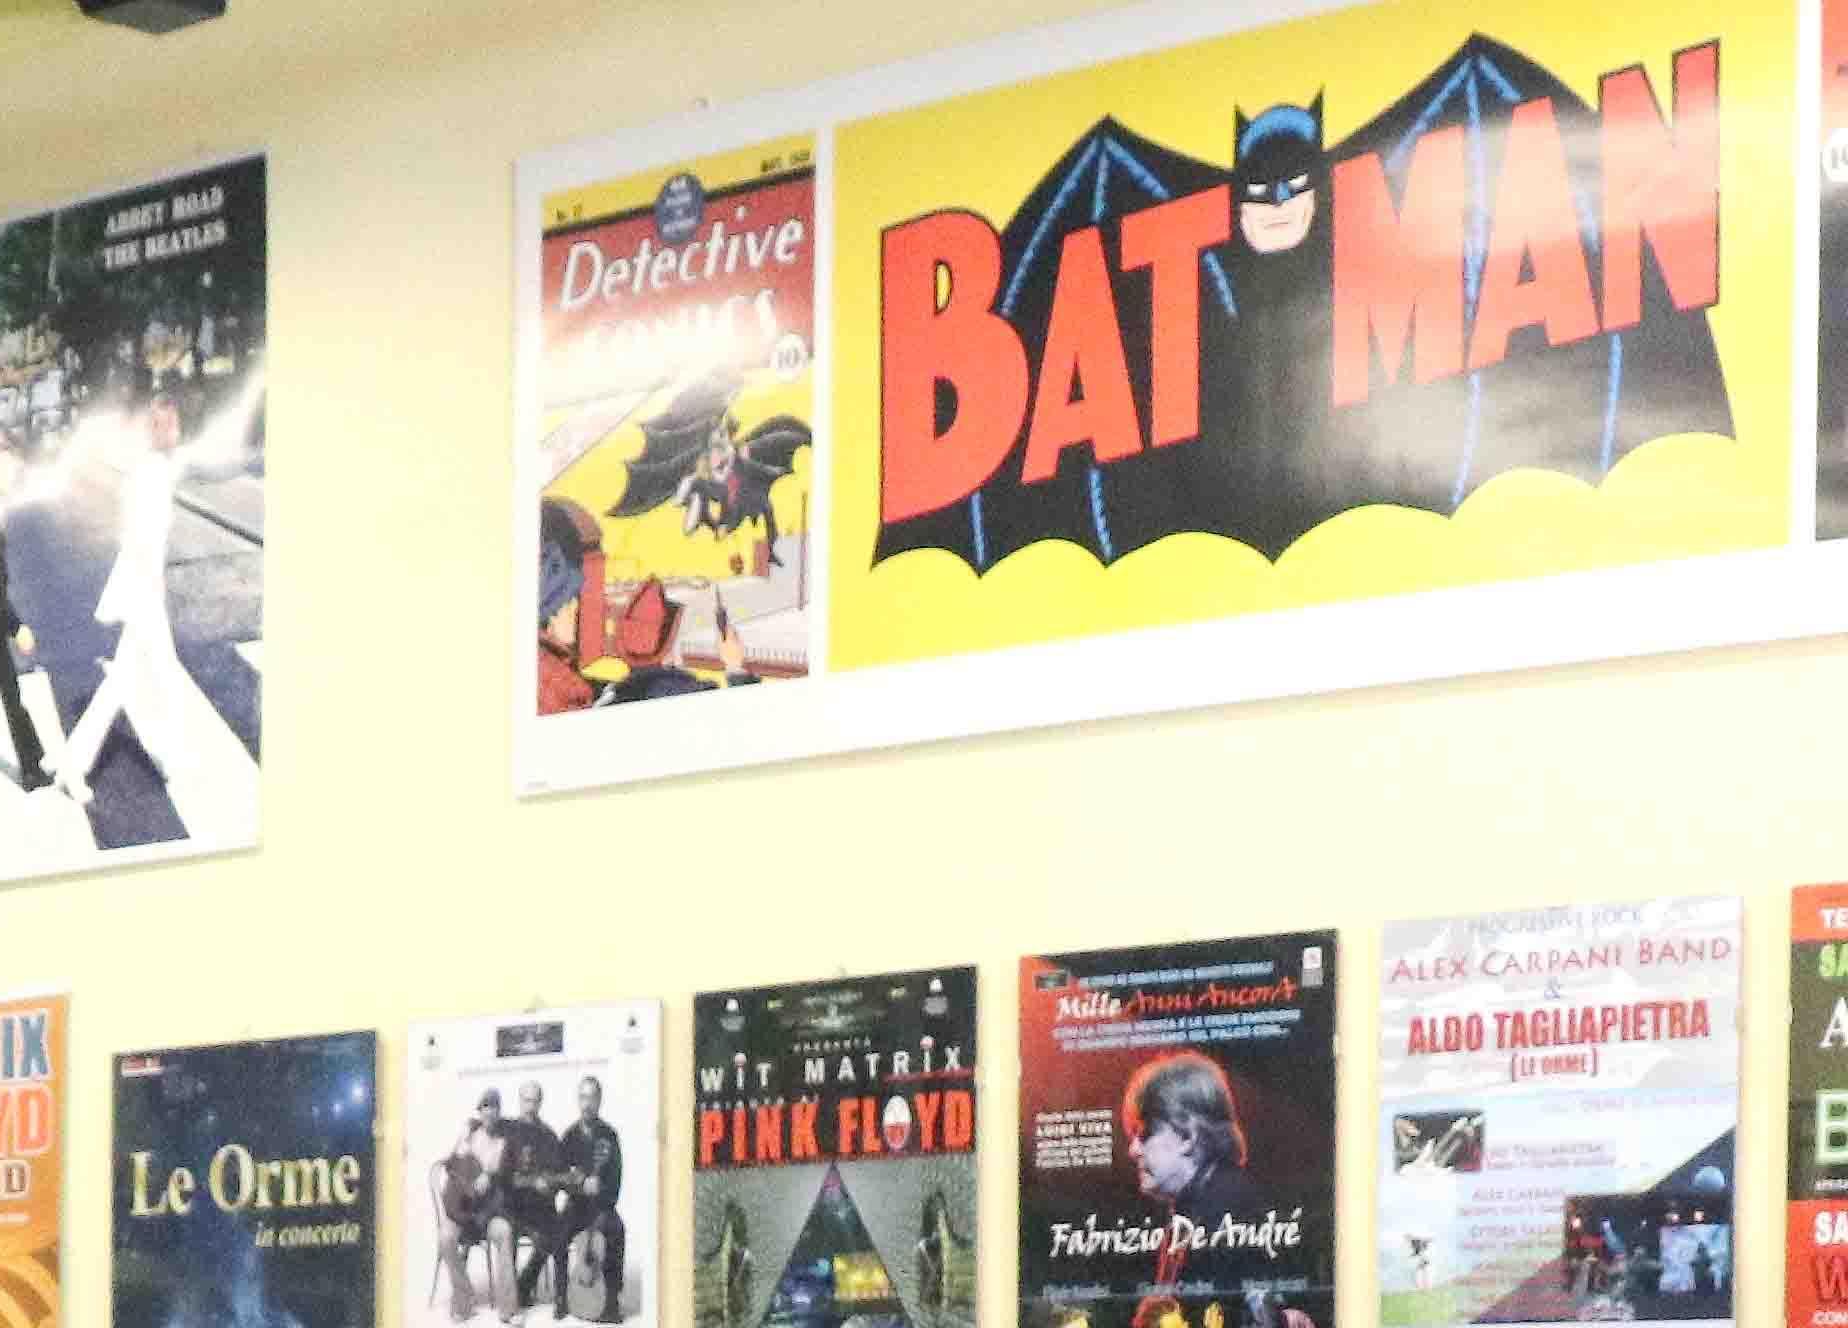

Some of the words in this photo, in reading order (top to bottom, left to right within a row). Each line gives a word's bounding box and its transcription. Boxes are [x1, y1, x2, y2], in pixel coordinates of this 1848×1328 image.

[104, 202, 166, 237] ABBEY
[172, 185, 225, 219] ROAD
[104, 242, 138, 270] THE
[145, 218, 227, 261] BEATLES
[560, 204, 804, 311] Detective
[881, 207, 1232, 524] BAT
[1332, 38, 1720, 408] MAN
[1391, 957, 1470, 983] ALEX
[1481, 944, 1626, 977] CARPANI
[1639, 937, 1733, 966] BAND
[1057, 989, 1120, 1020] Mille
[1407, 1012, 1485, 1057] ALDO
[1493, 999, 1711, 1051] TAGLIAPIETRA
[700, 1101, 821, 1168] PINK
[837, 1089, 975, 1153] FLOYD
[129, 1150, 195, 1216] Le
[209, 1143, 361, 1213] Orme
[1050, 1213, 1166, 1258] Fabrizio
[1166, 1214, 1207, 1254] De
[1210, 1206, 1303, 1259] André
